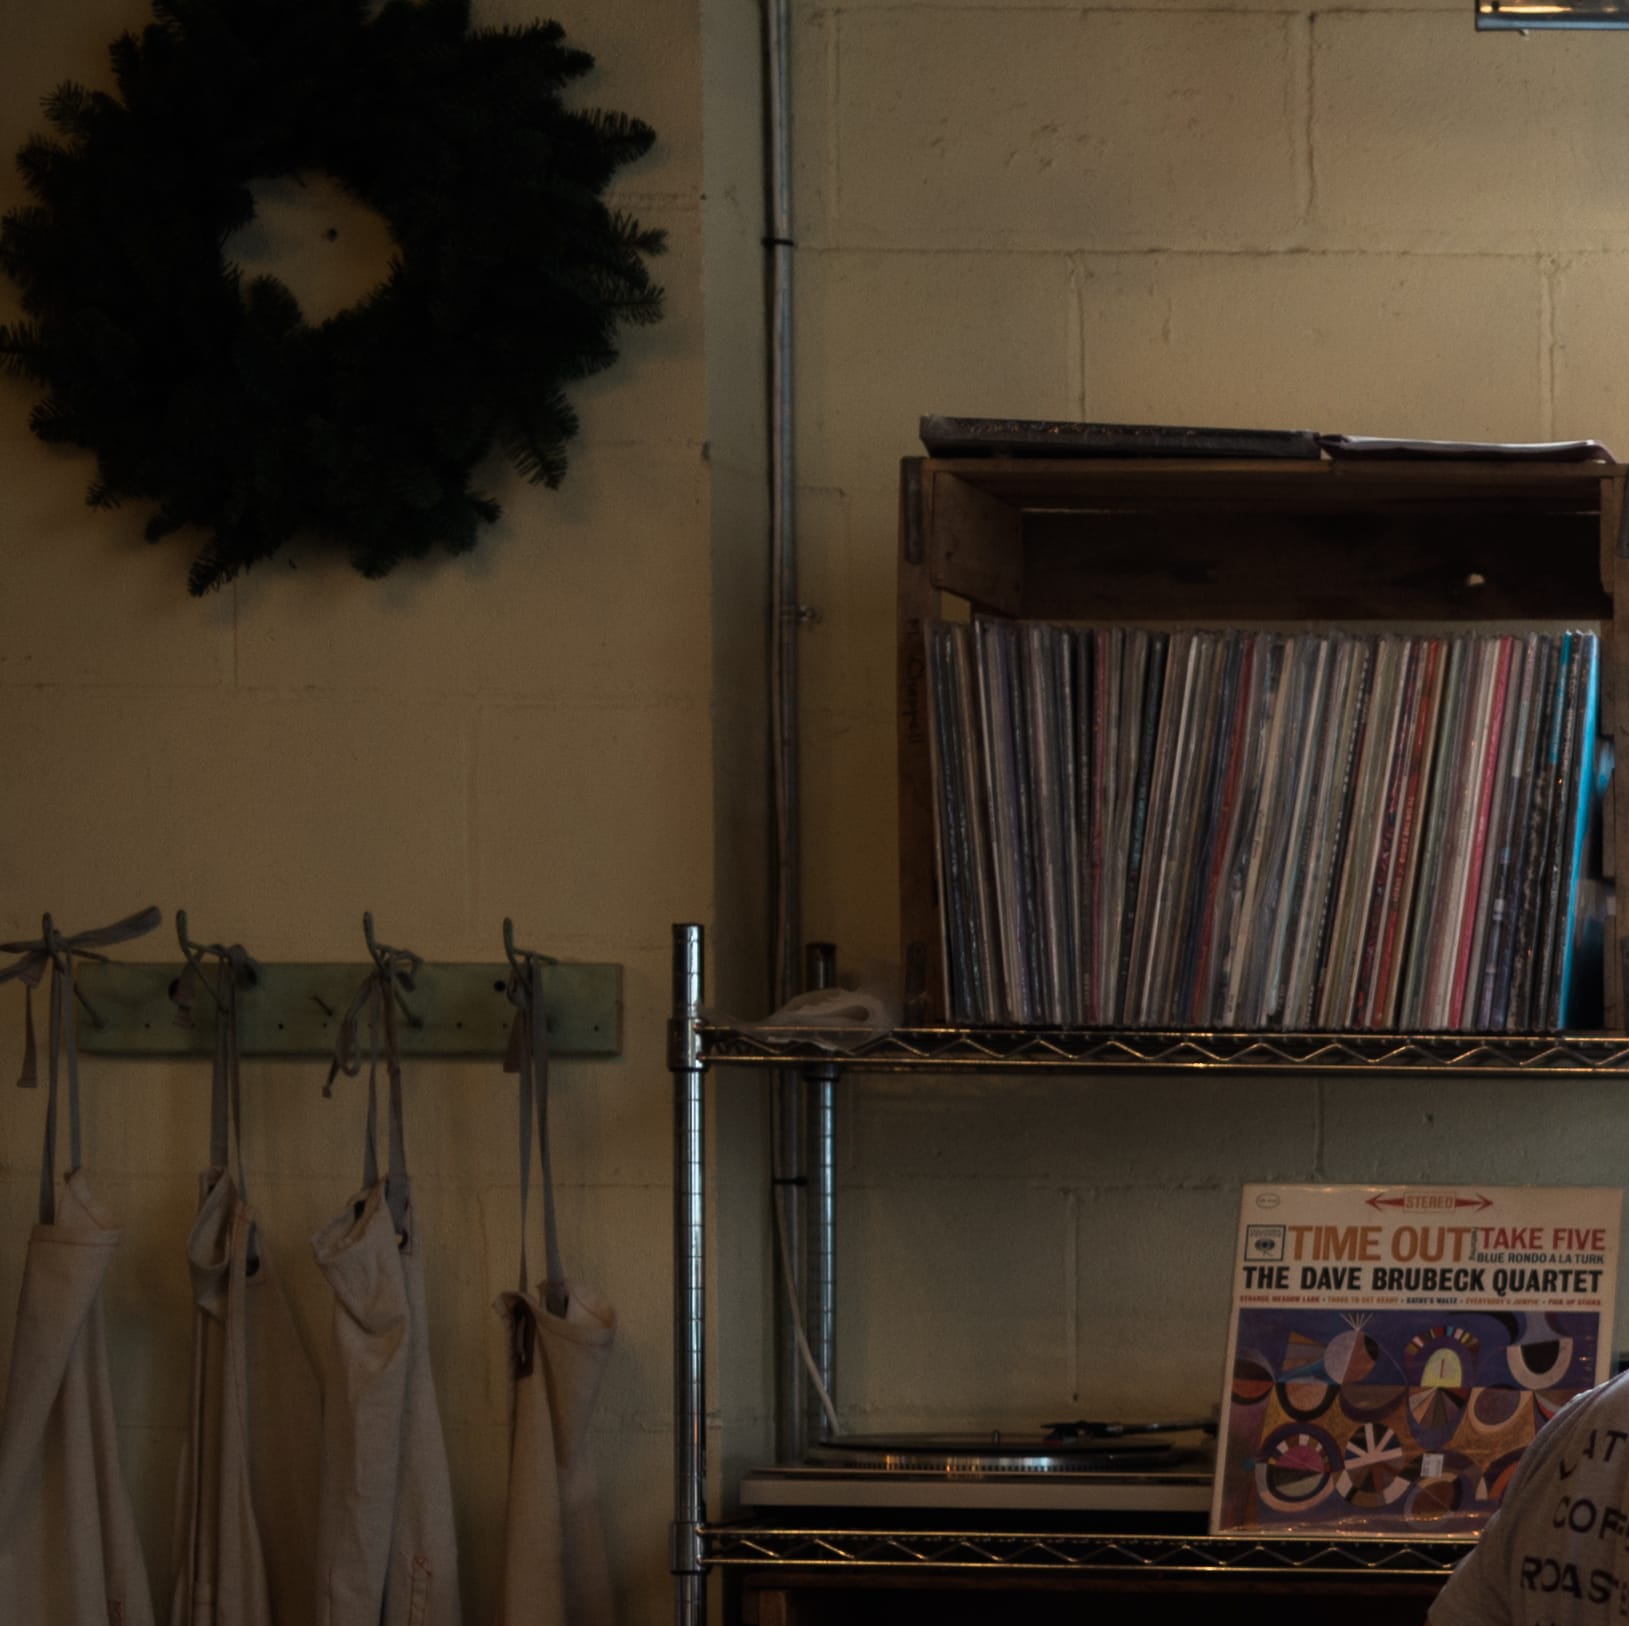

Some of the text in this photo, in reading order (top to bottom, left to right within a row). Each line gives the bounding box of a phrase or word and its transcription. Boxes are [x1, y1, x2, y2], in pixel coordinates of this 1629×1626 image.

[1407, 1195, 1455, 1210] STEREO
[1288, 1225, 1384, 1262] TIME
[1391, 1225, 1472, 1263] OUT
[1479, 1227, 1545, 1250] TAKE
[1552, 1227, 1607, 1251] FIVE
[1476, 1252, 1605, 1265] BLUE RONDO LA TURK
[1242, 1266, 1604, 1297] THE DAVE BRUBECK QUARTET
